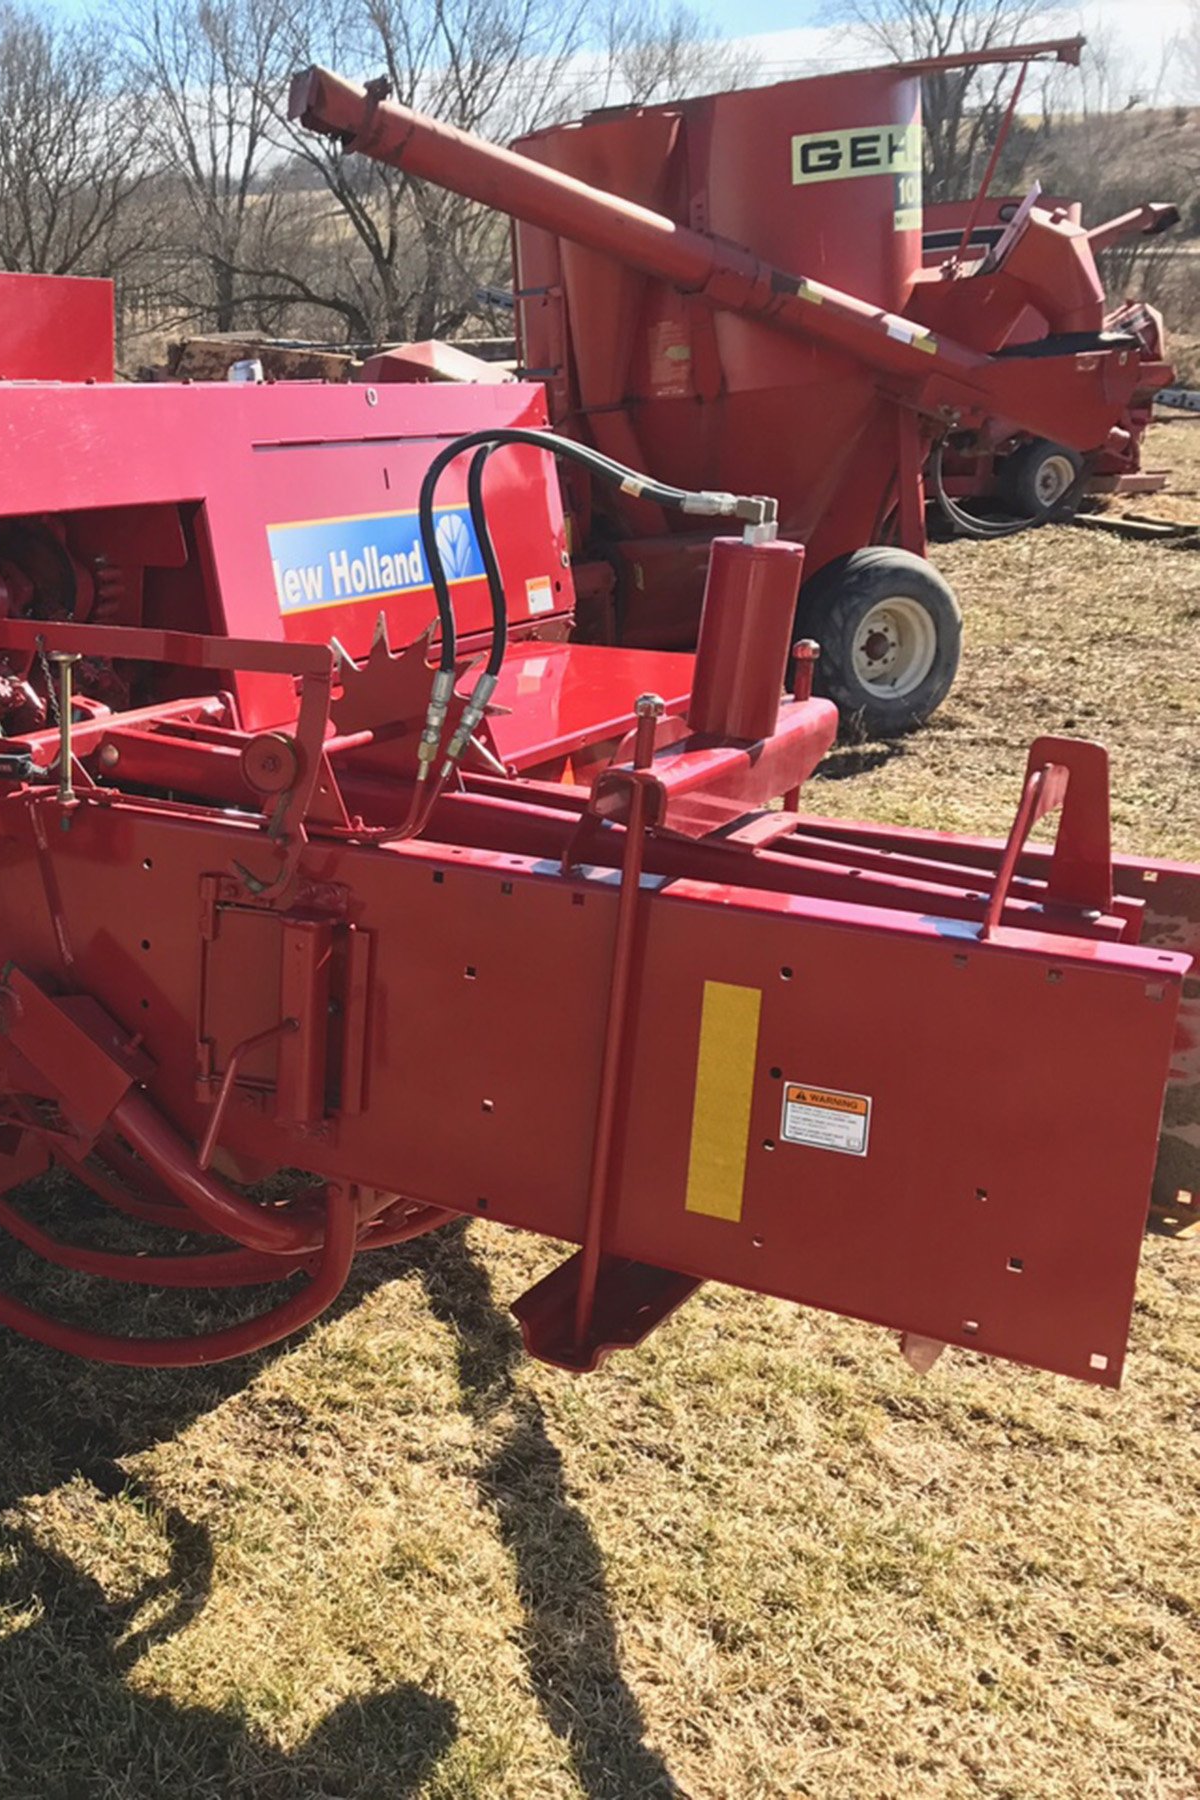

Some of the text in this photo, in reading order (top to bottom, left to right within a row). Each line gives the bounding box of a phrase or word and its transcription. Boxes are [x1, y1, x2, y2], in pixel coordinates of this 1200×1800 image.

[800, 132, 918, 174] GEH
[329, 539, 424, 596] Holland
[809, 1093, 858, 1110] WARNING
